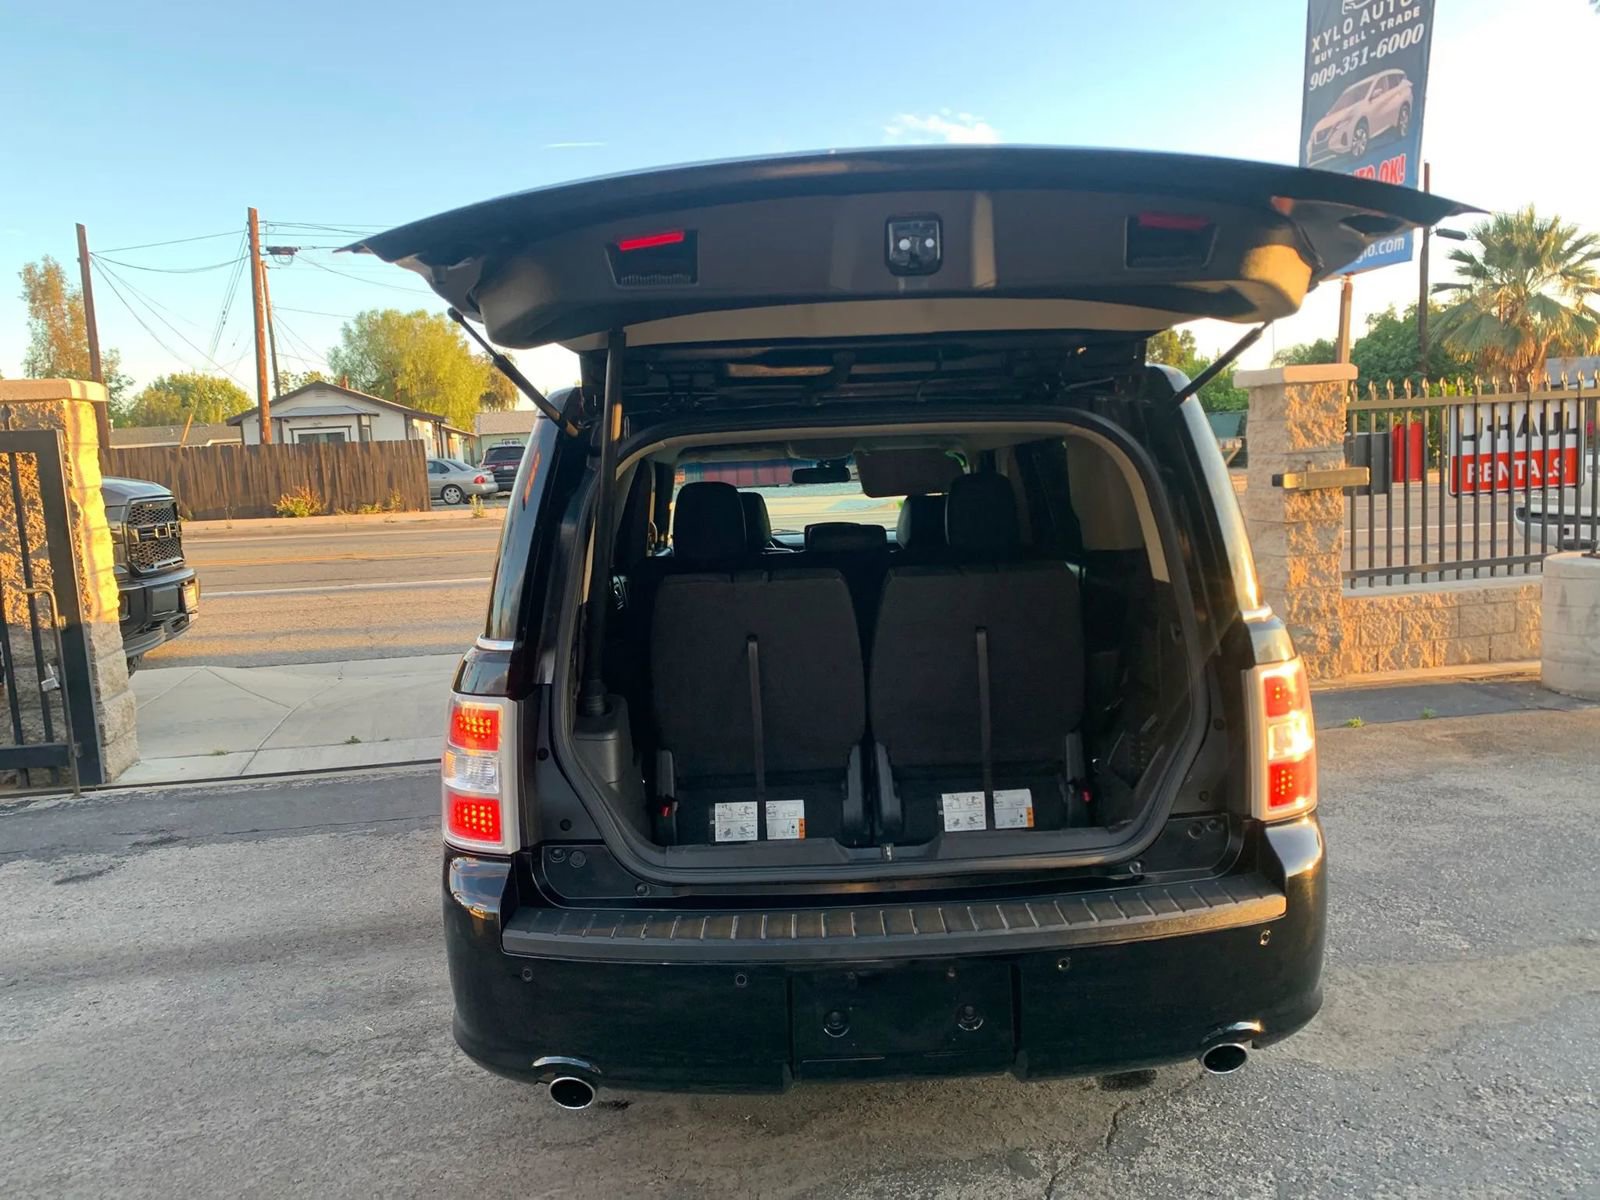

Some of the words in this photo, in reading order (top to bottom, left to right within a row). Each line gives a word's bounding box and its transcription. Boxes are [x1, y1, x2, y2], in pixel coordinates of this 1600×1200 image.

[1309, 23, 1424, 91] 909-351-6000
[1312, 18, 1353, 53] XYLO
[1314, 48, 1333, 65] BUY
[1343, 31, 1366, 50] SELL
[1380, 6, 1420, 31] TRADE
